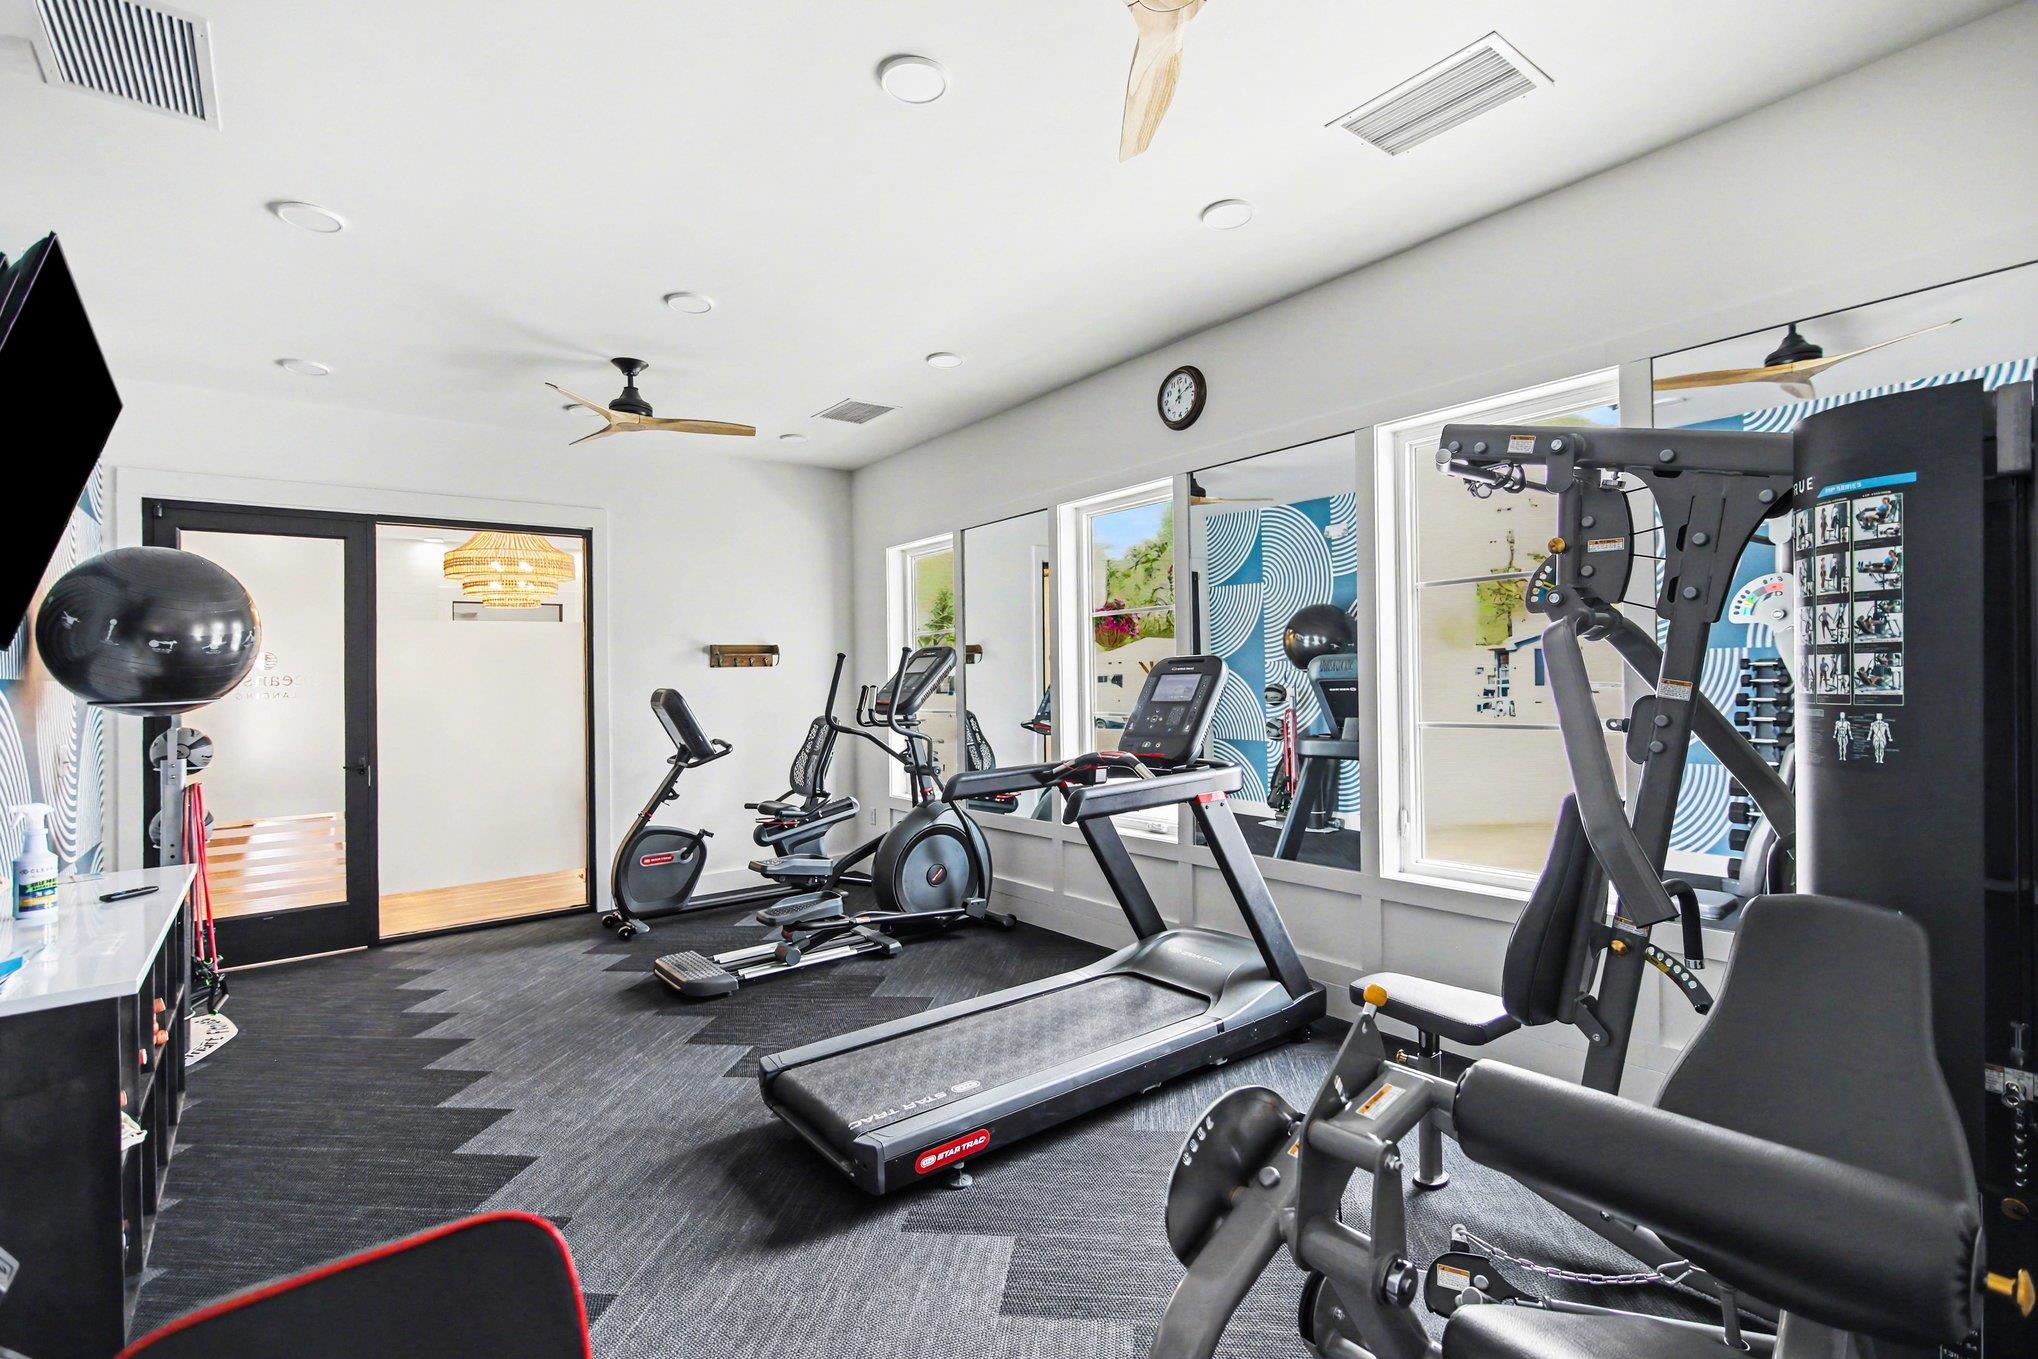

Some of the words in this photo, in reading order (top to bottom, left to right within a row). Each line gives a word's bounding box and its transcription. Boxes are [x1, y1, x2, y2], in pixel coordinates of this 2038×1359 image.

[1793, 476, 1813, 496] RUE
[902, 1091, 947, 1111] STAR
[848, 1108, 900, 1130] TRAC
[936, 1146, 961, 1161] STAR
[961, 1135, 987, 1151] TRAC
